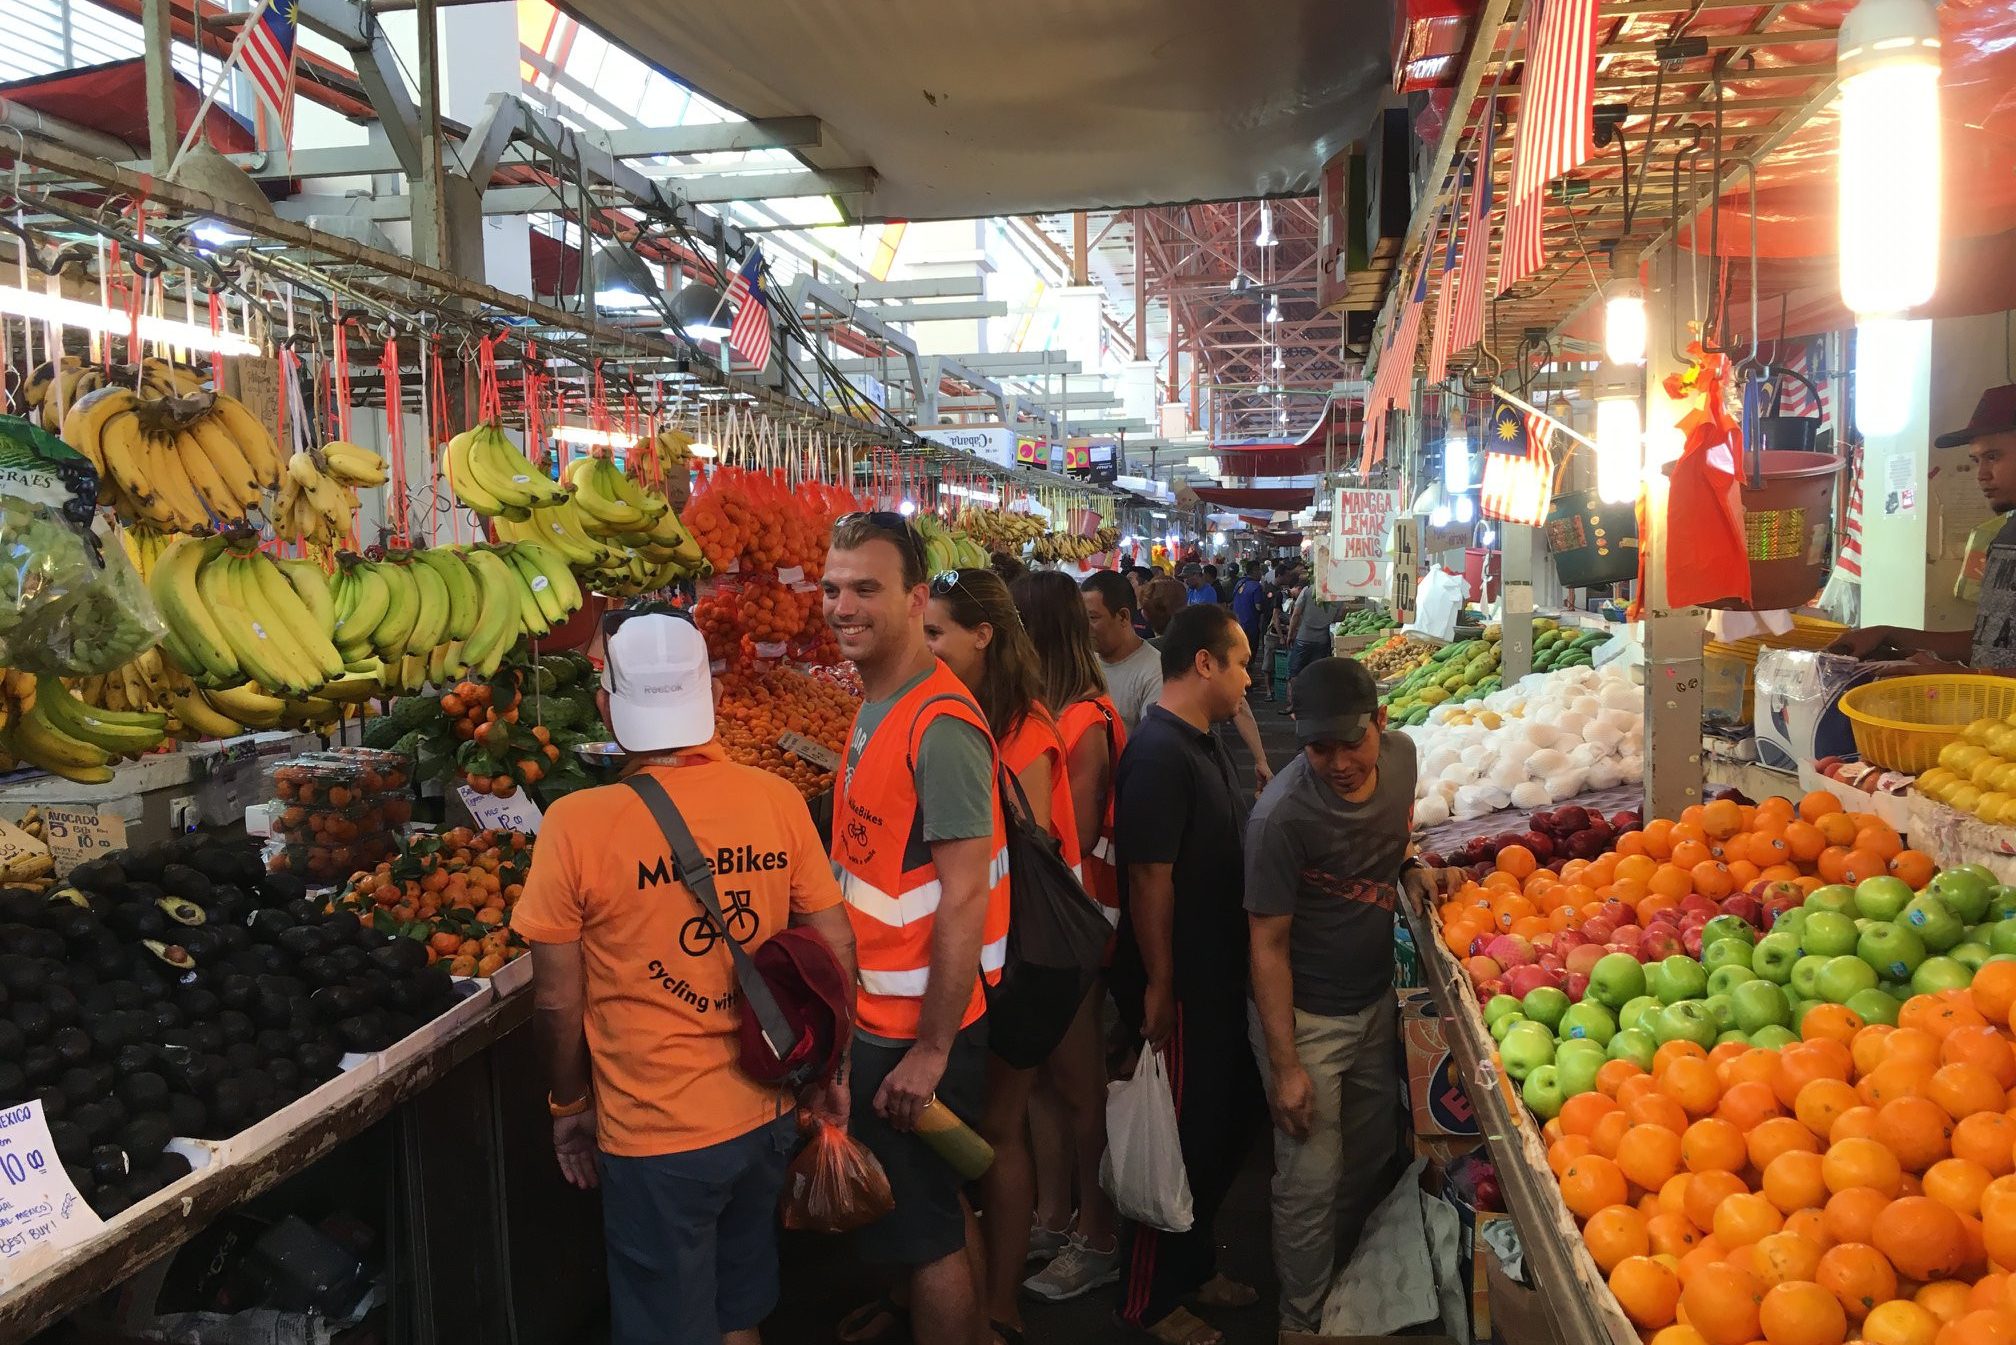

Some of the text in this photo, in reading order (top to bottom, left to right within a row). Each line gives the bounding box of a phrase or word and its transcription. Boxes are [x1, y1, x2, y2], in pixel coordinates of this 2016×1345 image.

[950, 433, 988, 448] Cabana
[1341, 513, 1389, 536] LEMAK
[1345, 537, 1382, 558] MANIS
[644, 684, 683, 694] Reebok
[48, 811, 99, 826] AVOCADO
[49, 821, 68, 838] 5
[77, 835, 94, 848] 10
[638, 845, 788, 890] MieBikes
[648, 959, 738, 1013] cycling wit
[0, 1106, 31, 1129] EXICO
[27, 1150, 45, 1169] 00
[0, 1231, 27, 1254] BEST
